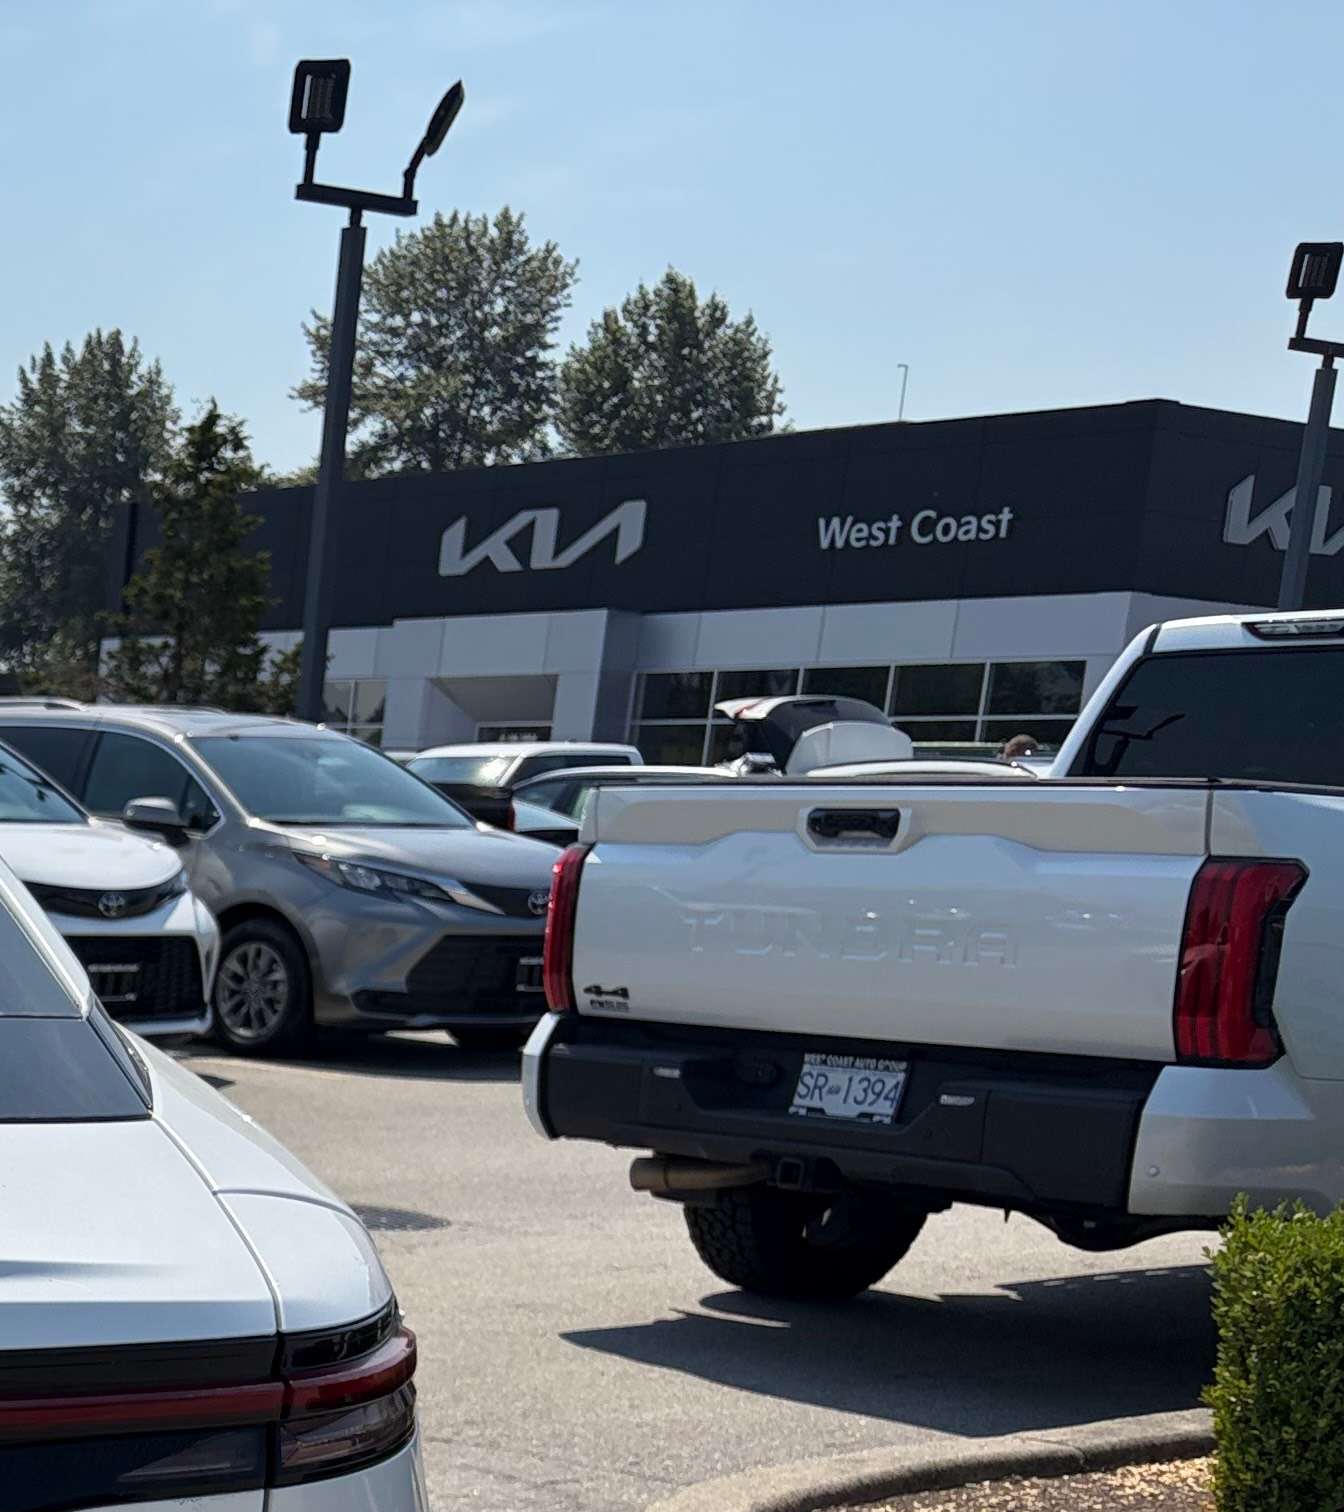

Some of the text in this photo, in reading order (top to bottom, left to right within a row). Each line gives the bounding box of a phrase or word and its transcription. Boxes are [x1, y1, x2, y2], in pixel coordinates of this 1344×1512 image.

[438, 499, 647, 577] KIA
[818, 506, 1014, 550] West Coast
[1223, 474, 1344, 556] KI
[680, 908, 1018, 969] TUNDRA
